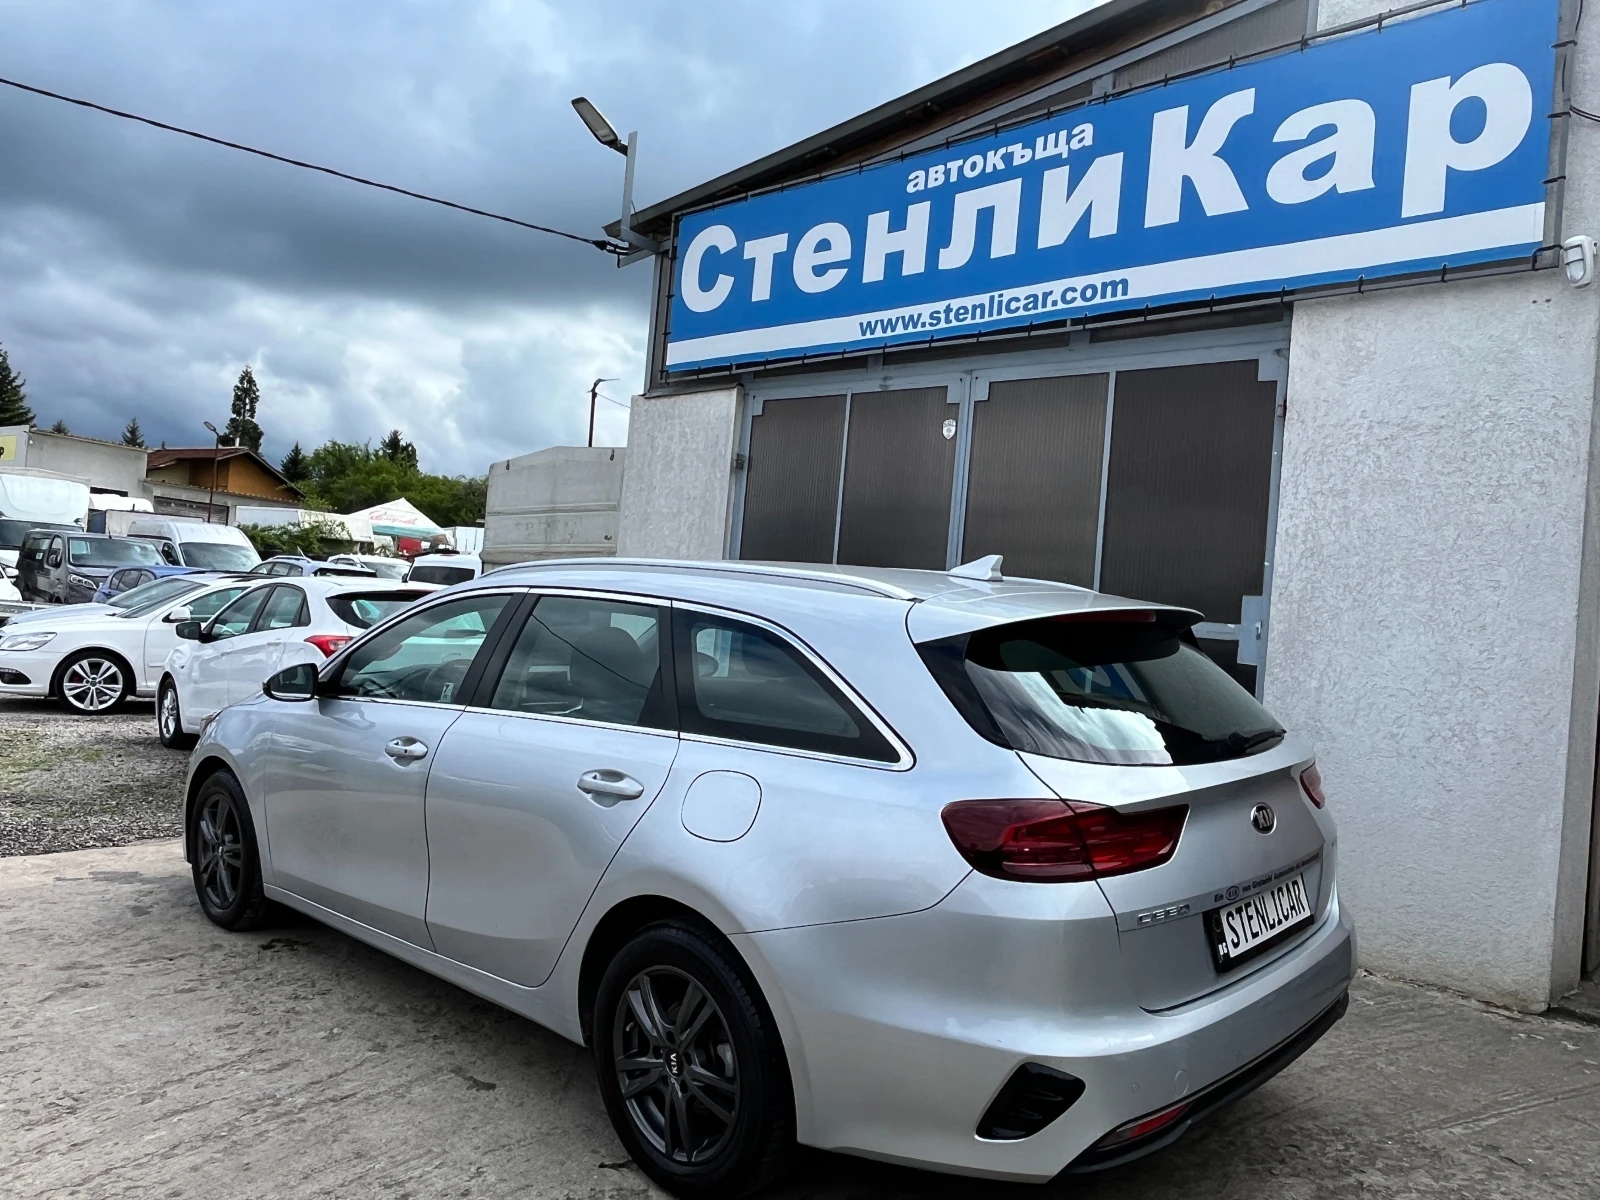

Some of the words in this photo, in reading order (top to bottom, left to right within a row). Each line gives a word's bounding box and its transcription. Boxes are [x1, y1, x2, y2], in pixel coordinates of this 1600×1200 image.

[906, 122, 1094, 194] автокъща
[859, 277, 1129, 336] www.stenlicar.com
[1225, 878, 1306, 950] STENLICAR
[670, 1052, 678, 1074] KIA
